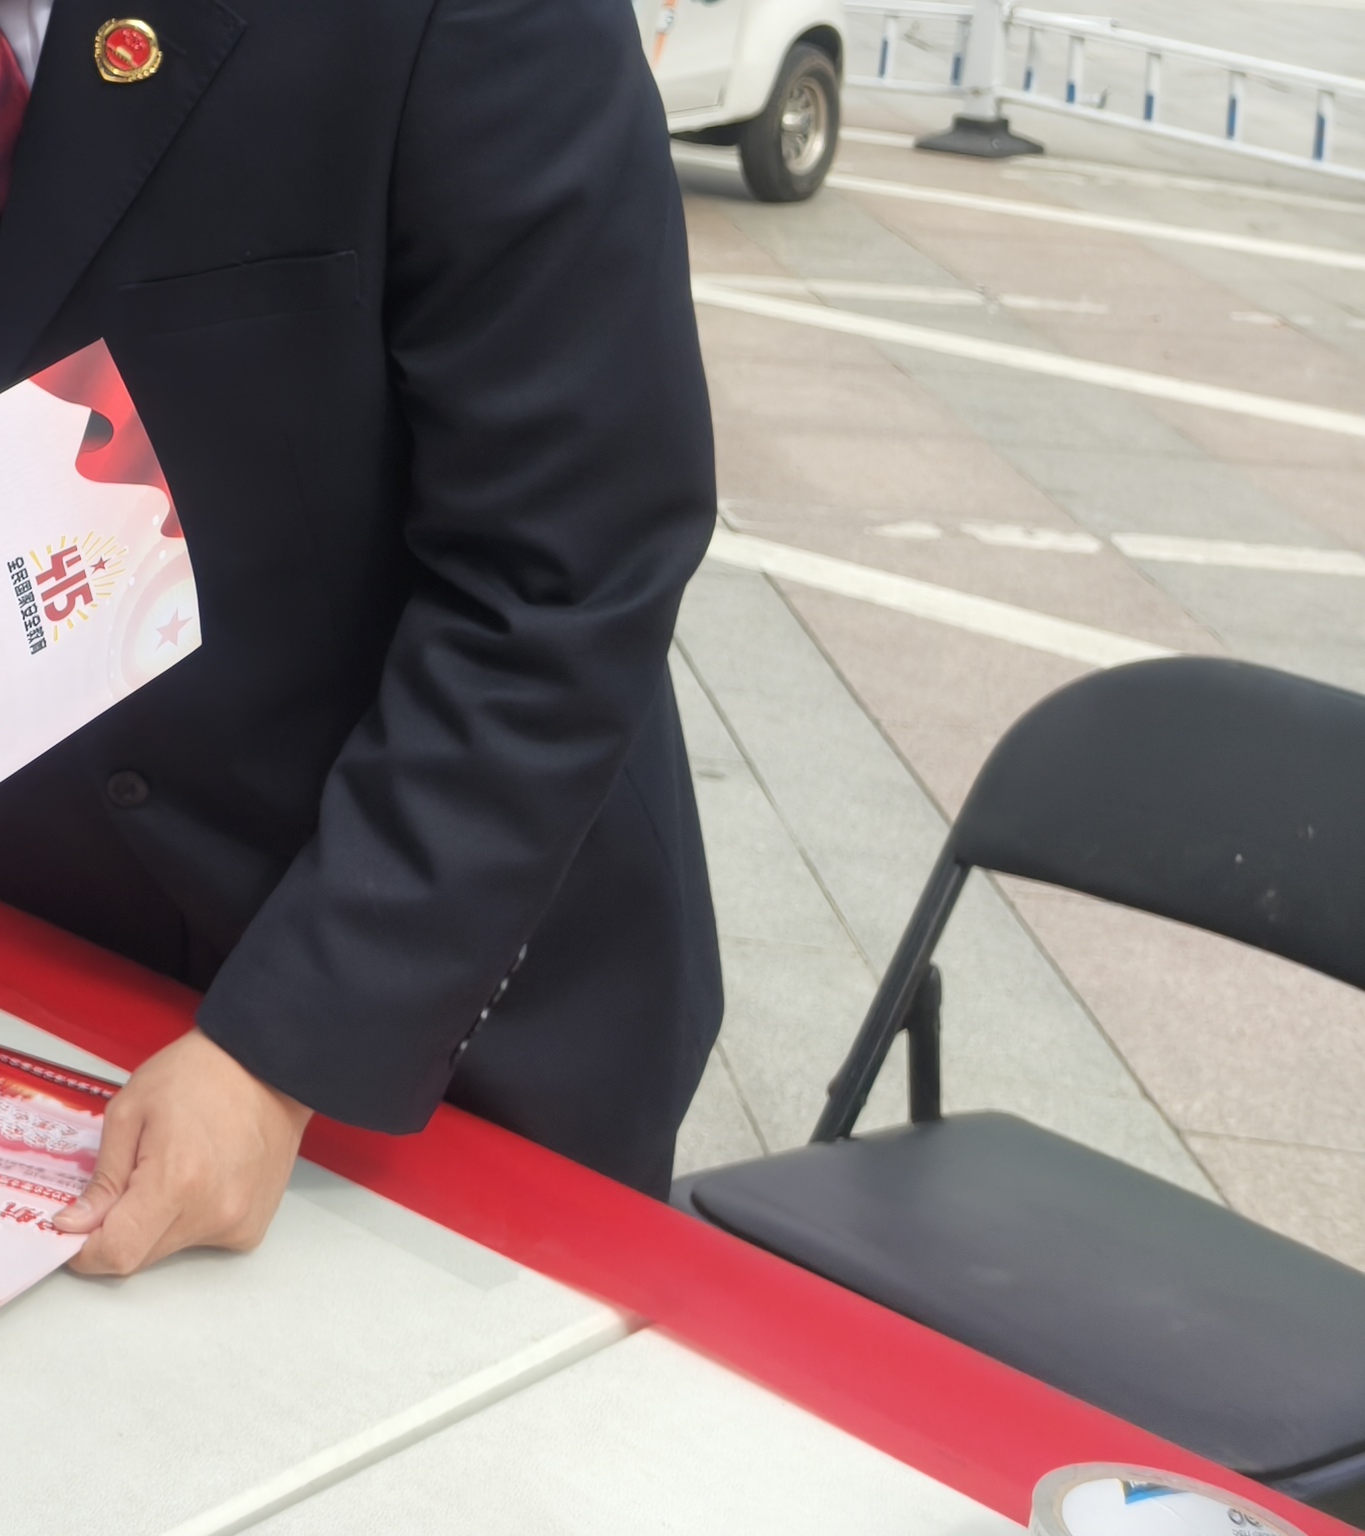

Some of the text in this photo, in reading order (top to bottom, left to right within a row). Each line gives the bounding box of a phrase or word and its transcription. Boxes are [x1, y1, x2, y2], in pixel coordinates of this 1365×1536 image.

[7, 557, 47, 655] 全民国家安全教育
[35, 545, 93, 621] 415
